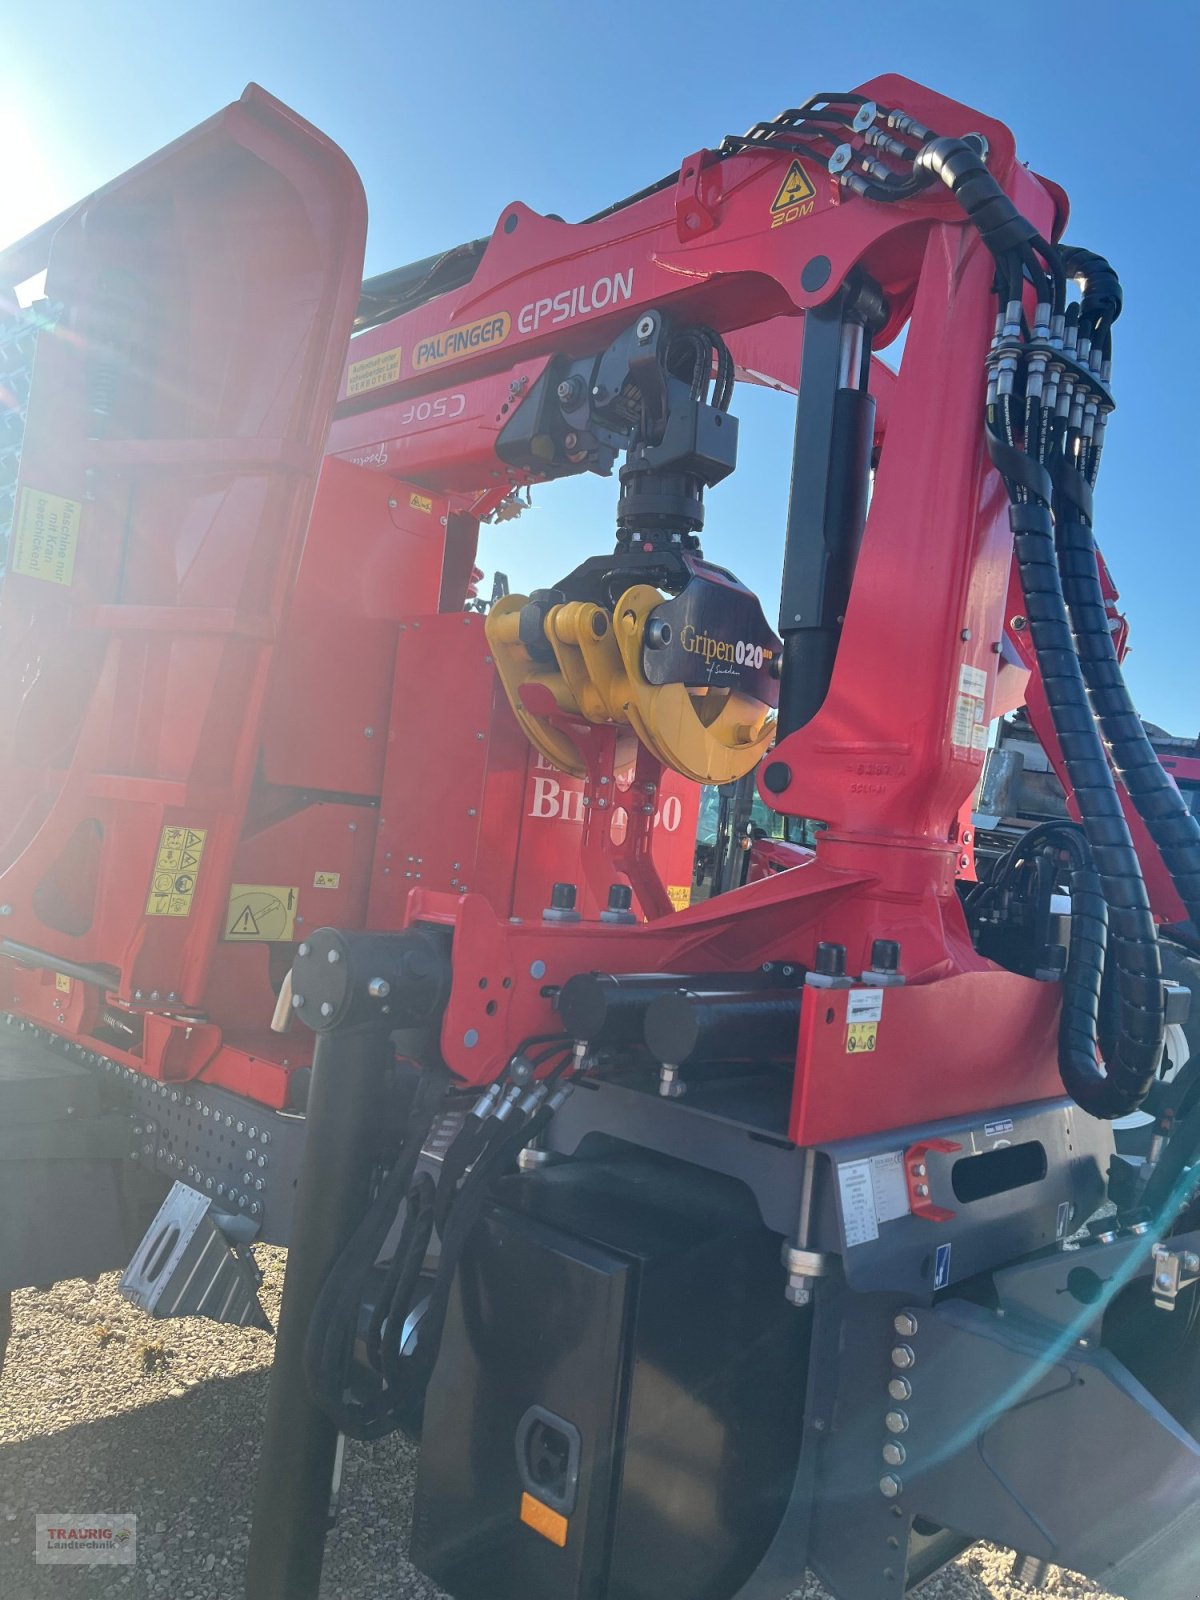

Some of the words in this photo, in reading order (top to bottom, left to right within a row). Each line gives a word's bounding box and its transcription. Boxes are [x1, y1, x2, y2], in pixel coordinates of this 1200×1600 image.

[517, 267, 635, 334] EPSILON
[416, 317, 505, 366] PALFINGER
[401, 393, 466, 425] C50F
[44, 534, 56, 564] Kran
